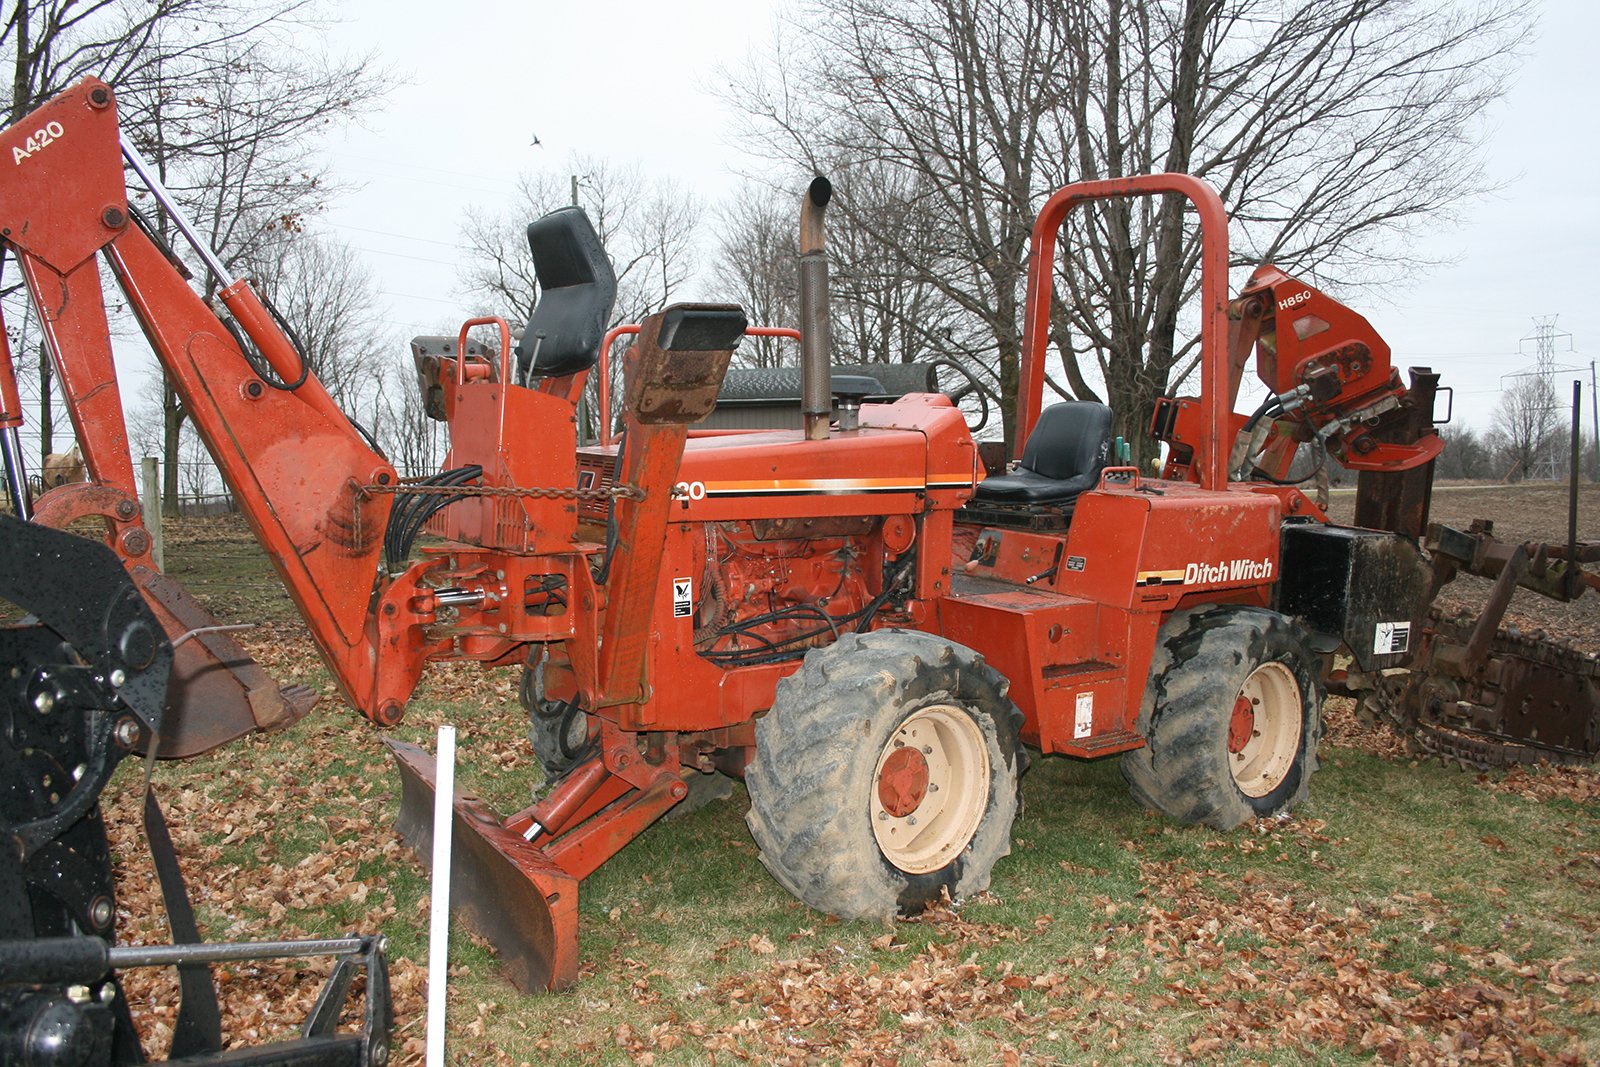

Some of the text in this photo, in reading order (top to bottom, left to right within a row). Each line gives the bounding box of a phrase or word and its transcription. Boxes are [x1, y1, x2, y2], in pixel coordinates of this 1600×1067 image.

[12, 121, 65, 166] A420
[1278, 290, 1311, 310] H850
[671, 481, 705, 501] 20
[1184, 558, 1273, 585] Ditch Witch
